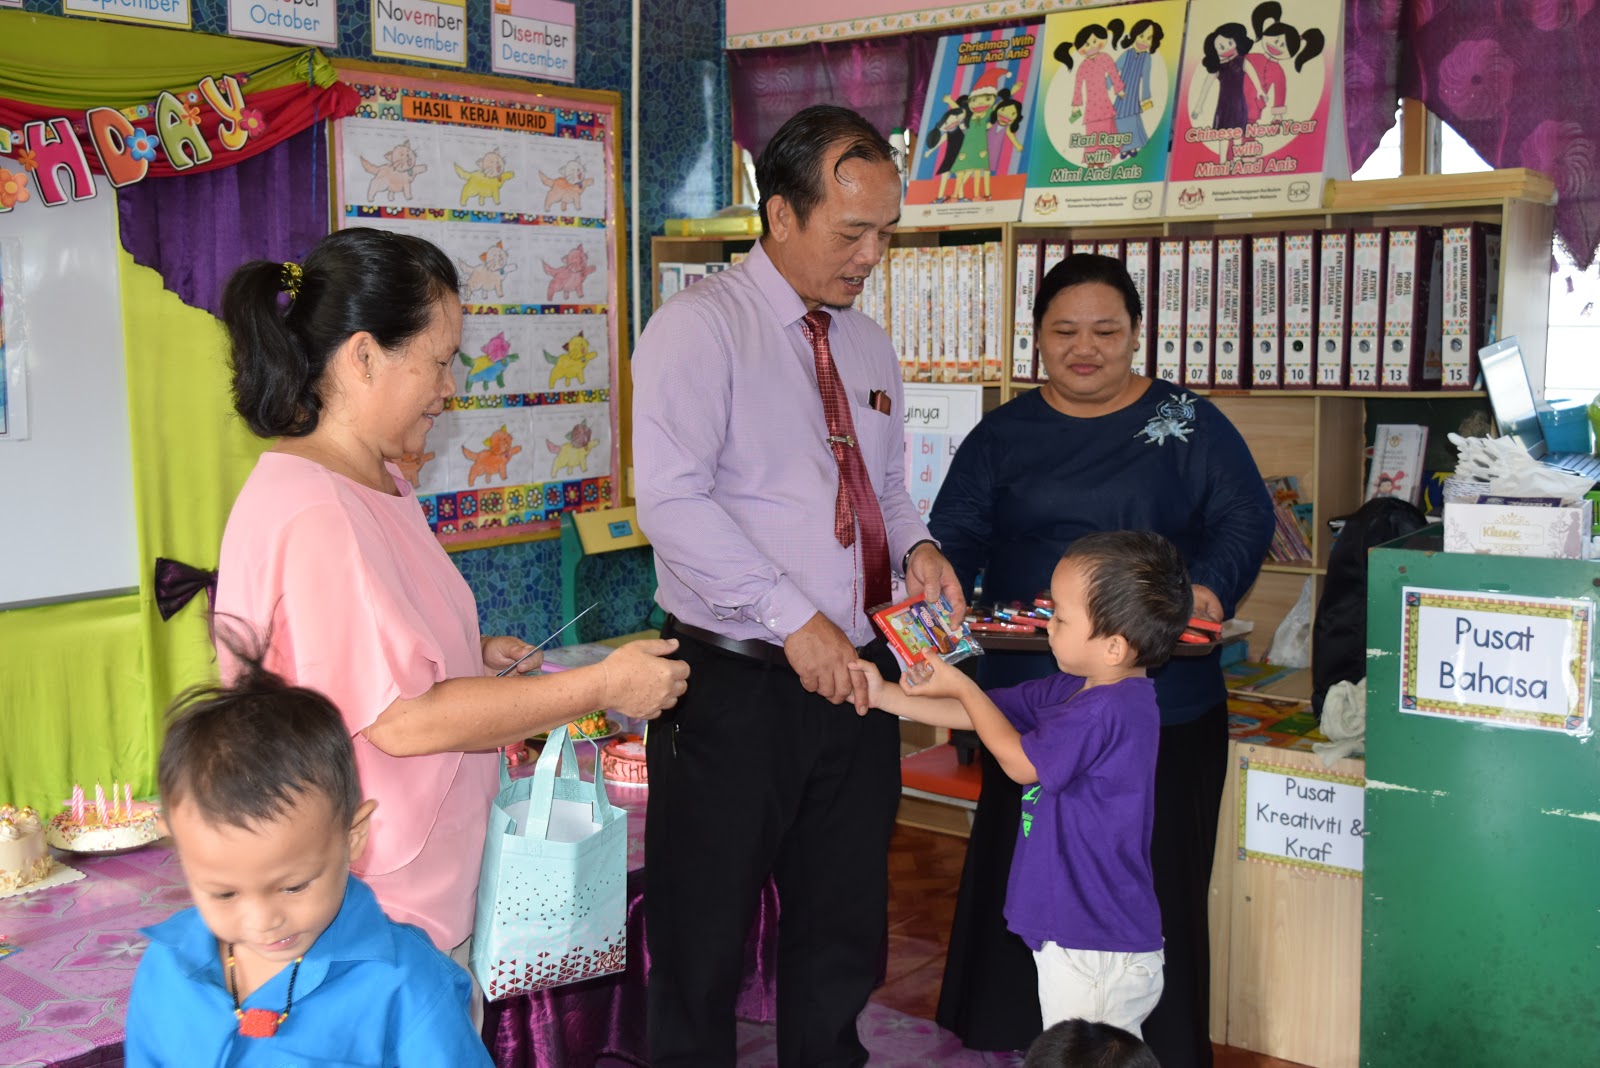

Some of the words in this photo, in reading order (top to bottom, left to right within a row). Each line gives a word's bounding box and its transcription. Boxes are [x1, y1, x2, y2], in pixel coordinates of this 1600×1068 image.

[250, 4, 320, 31] October
[377, 0, 464, 31] November
[382, 25, 460, 54] November
[501, 19, 569, 48] Disember
[957, 38, 1009, 54] Christmas
[1010, 34, 1035, 48] With
[502, 43, 569, 69] December
[957, 53, 982, 66] Mimi
[983, 50, 1005, 62] And
[1006, 48, 1030, 60] Anis
[412, 100, 453, 119] HASIL
[460, 104, 500, 125] KERJA
[506, 111, 547, 130] MURID
[1069, 133, 1096, 148] Hari
[1099, 131, 1132, 148] Raya
[1184, 126, 1243, 143] Chinese
[1245, 124, 1278, 138] New
[1281, 119, 1317, 134] Year
[1085, 150, 1113, 164] with
[1233, 142, 1262, 157] with
[1050, 168, 1083, 183] Mimi
[1084, 166, 1111, 181] And
[1112, 164, 1142, 179] Anis
[1194, 162, 1230, 178] Mimi
[1231, 159, 1262, 175] And
[1265, 156, 1297, 172] Anis
[1459, 244, 1468, 261] DATA
[1301, 259, 1309, 281] HARTA
[1459, 262, 1468, 300] MAKLUMAT
[1293, 268, 1301, 305] INVENTORI
[1301, 282, 1309, 306] MODAL
[1327, 266, 1335, 306] PELUPUSAN
[1361, 268, 1369, 302] TAHUNAN
[1369, 270, 1377, 300] AKTIVITI
[1395, 272, 1403, 296] MURID
[1403, 271, 1412, 296] PROFIL
[1194, 288, 1202, 312] SIARAN
[1459, 300, 1468, 318] ASAS
[1017, 363, 1026, 374] 01
[1162, 368, 1174, 379] 06
[1191, 368, 1203, 379] 07
[1221, 369, 1233, 380] 08
[1258, 369, 1272, 380] 09
[1291, 369, 1304, 380] 10
[1324, 369, 1334, 380] 11
[1357, 369, 1370, 380] 12
[1389, 369, 1402, 380] 13
[1450, 369, 1462, 380] 15
[921, 436, 934, 454] bi
[920, 464, 932, 482] di
[917, 497, 930, 515] gi
[1455, 616, 1535, 652] Pusat
[1439, 660, 1548, 700] Bahasa
[1285, 777, 1337, 804] Pusat
[1256, 802, 1342, 835] Kreativiti
[1350, 819, 1365, 839] &
[1285, 837, 1333, 862] Kraf
